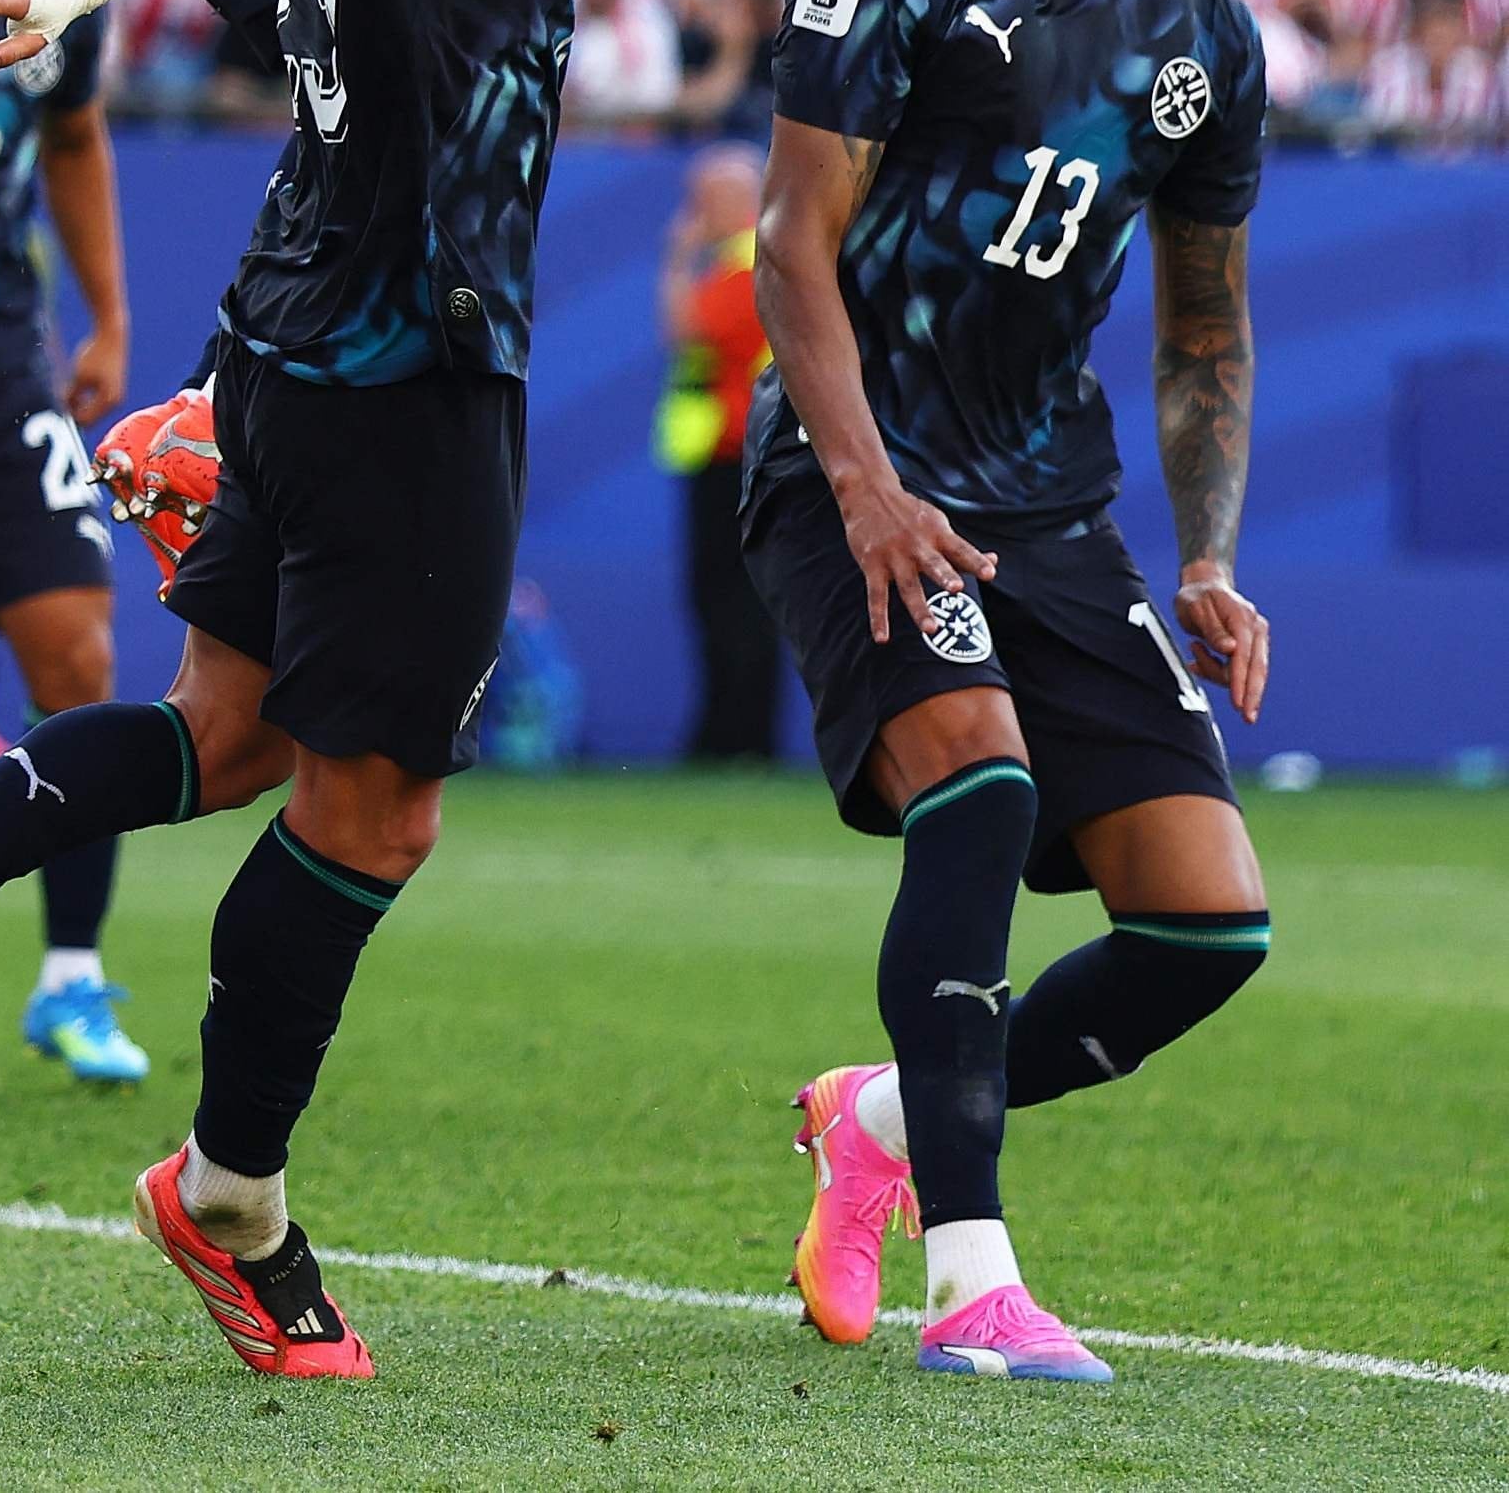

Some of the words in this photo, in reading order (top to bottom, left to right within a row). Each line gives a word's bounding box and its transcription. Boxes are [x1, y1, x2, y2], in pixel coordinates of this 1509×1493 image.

[982, 144, 1100, 281] 13
[22, 409, 103, 512] 2
[1127, 601, 1212, 713] 1
